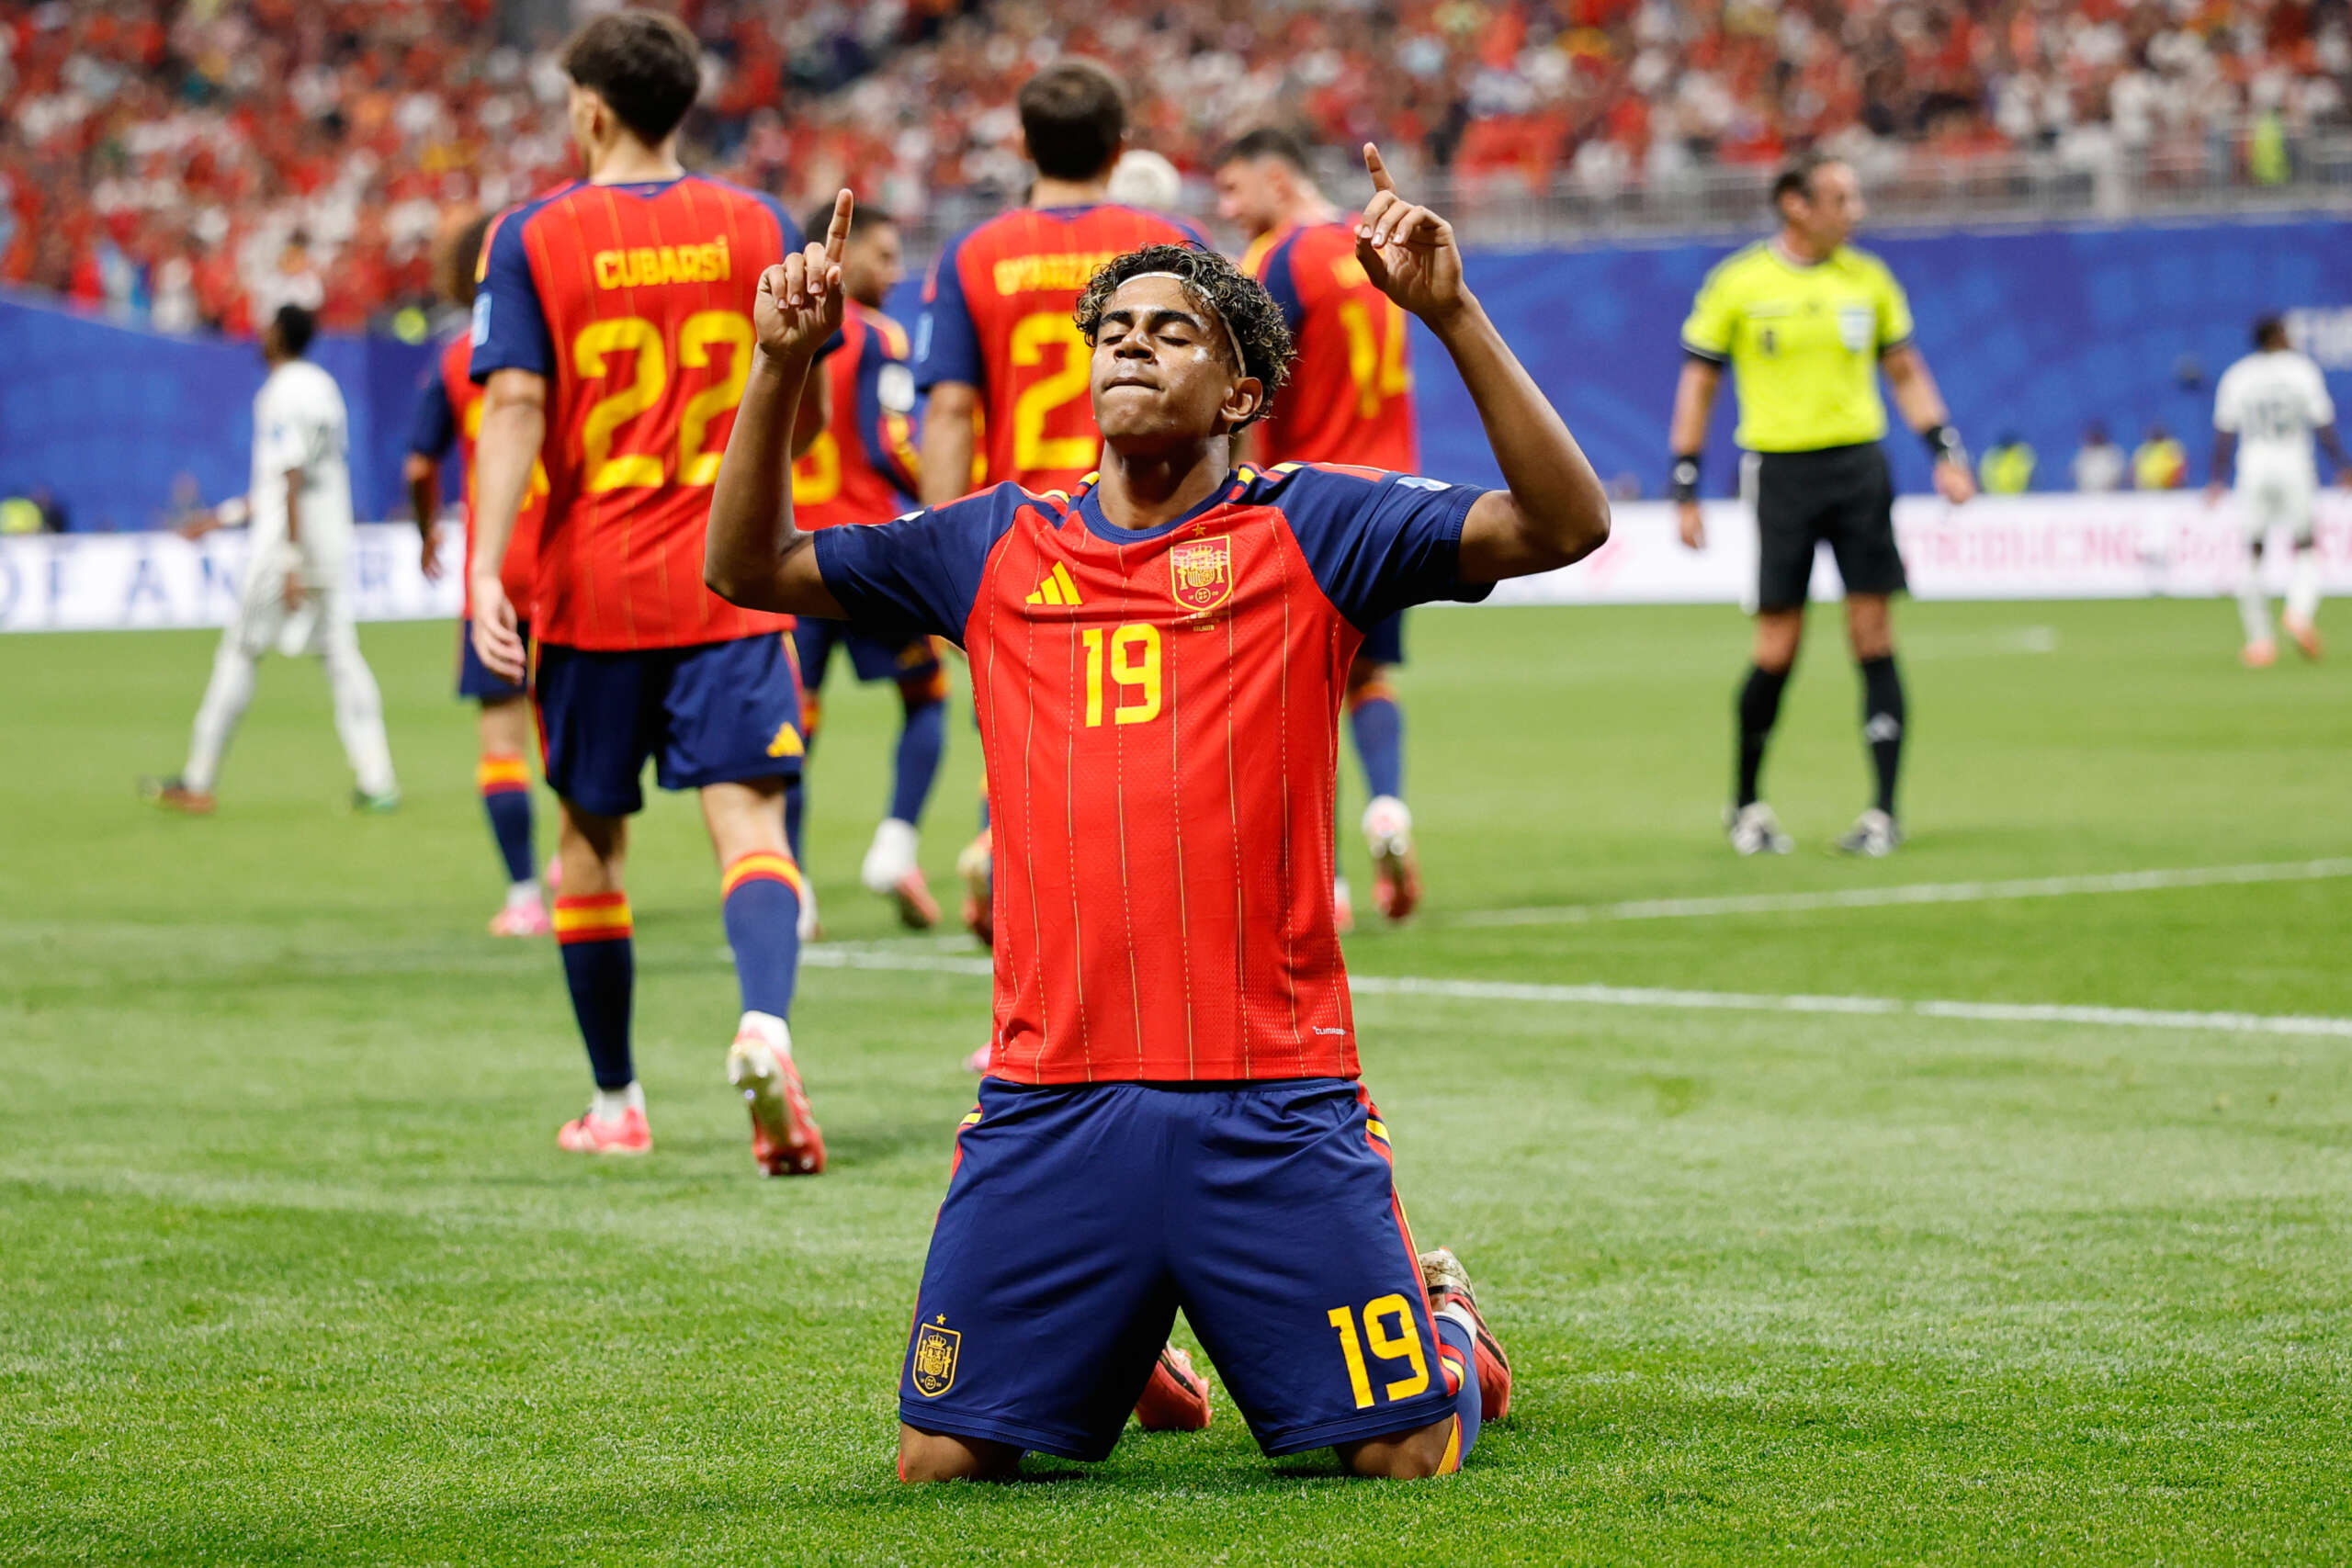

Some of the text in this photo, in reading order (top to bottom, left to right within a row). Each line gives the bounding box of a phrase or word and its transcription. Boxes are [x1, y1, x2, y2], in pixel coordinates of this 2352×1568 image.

[594, 235, 731, 290] CUBARSÍ
[573, 310, 755, 492] 22
[1011, 310, 1098, 471] 2
[1082, 623, 1162, 728] 19
[1327, 1293, 1430, 1409] 19
